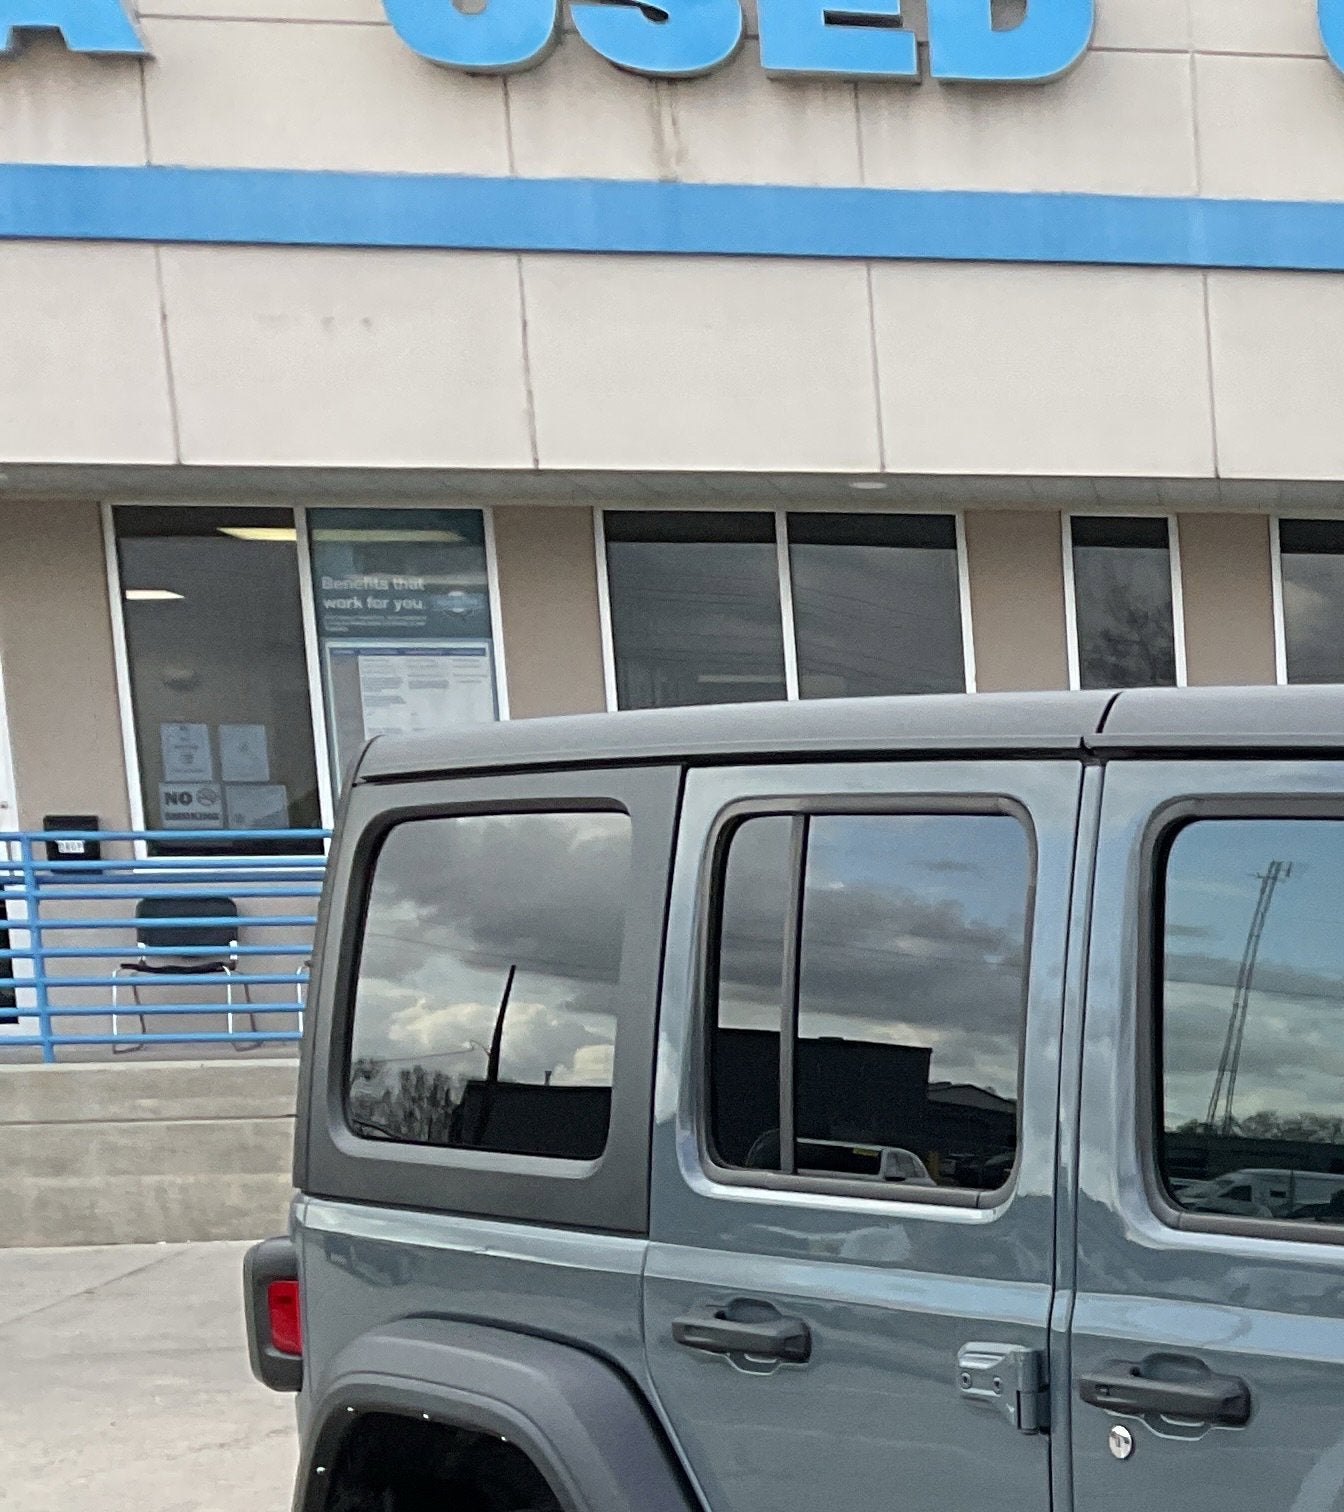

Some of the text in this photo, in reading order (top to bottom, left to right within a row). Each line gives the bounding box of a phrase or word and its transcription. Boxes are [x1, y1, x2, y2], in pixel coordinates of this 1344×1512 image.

[321, 576, 425, 590] Benefits that
[324, 596, 363, 609] work
[366, 595, 389, 609] for
[164, 791, 193, 806] NO
